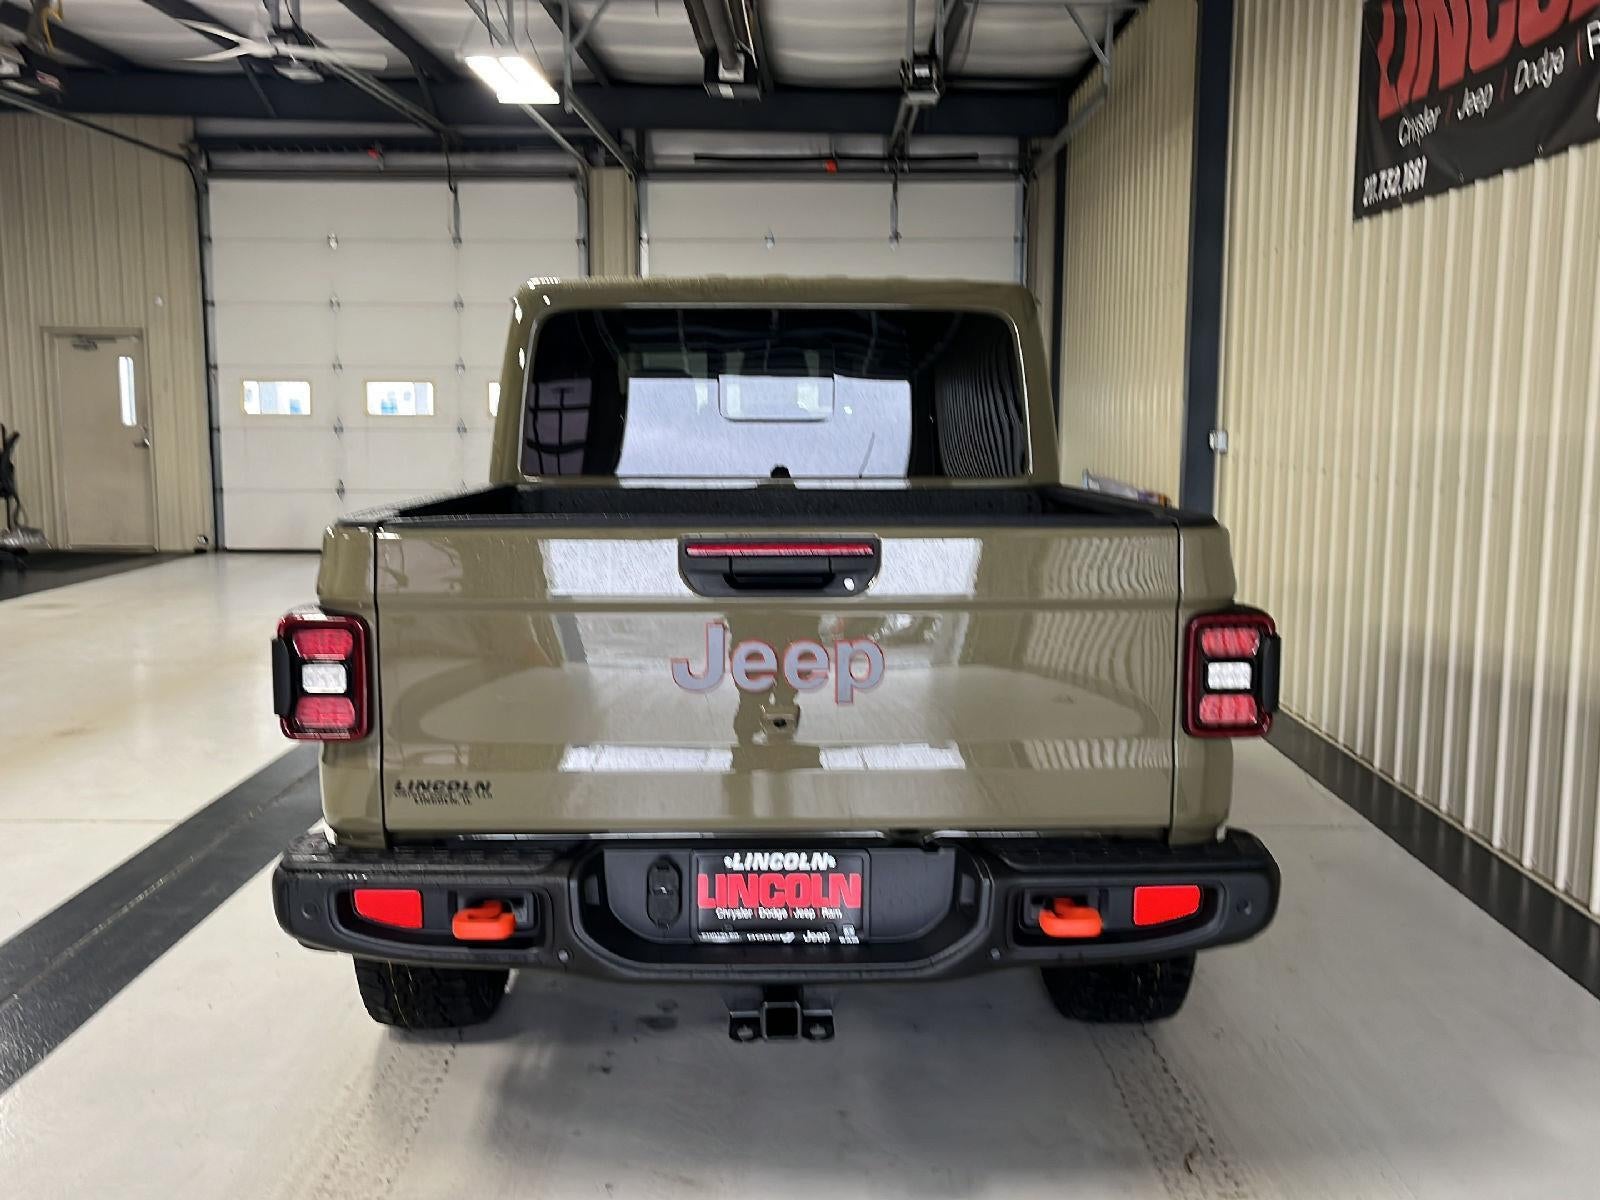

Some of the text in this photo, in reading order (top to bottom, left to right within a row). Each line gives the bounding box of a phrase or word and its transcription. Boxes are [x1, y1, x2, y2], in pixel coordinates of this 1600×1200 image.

[1457, 83, 1493, 120] Jeep
[1514, 46, 1565, 95] Dodge
[671, 622, 885, 704] Jeep
[394, 779, 492, 793] LINCOLN
[732, 851, 830, 871] LINCOLN
[697, 872, 862, 909] LINCOLN
[715, 907, 843, 921] Chrysler Dodge Jeep Ram
[802, 930, 831, 944] Jeep
